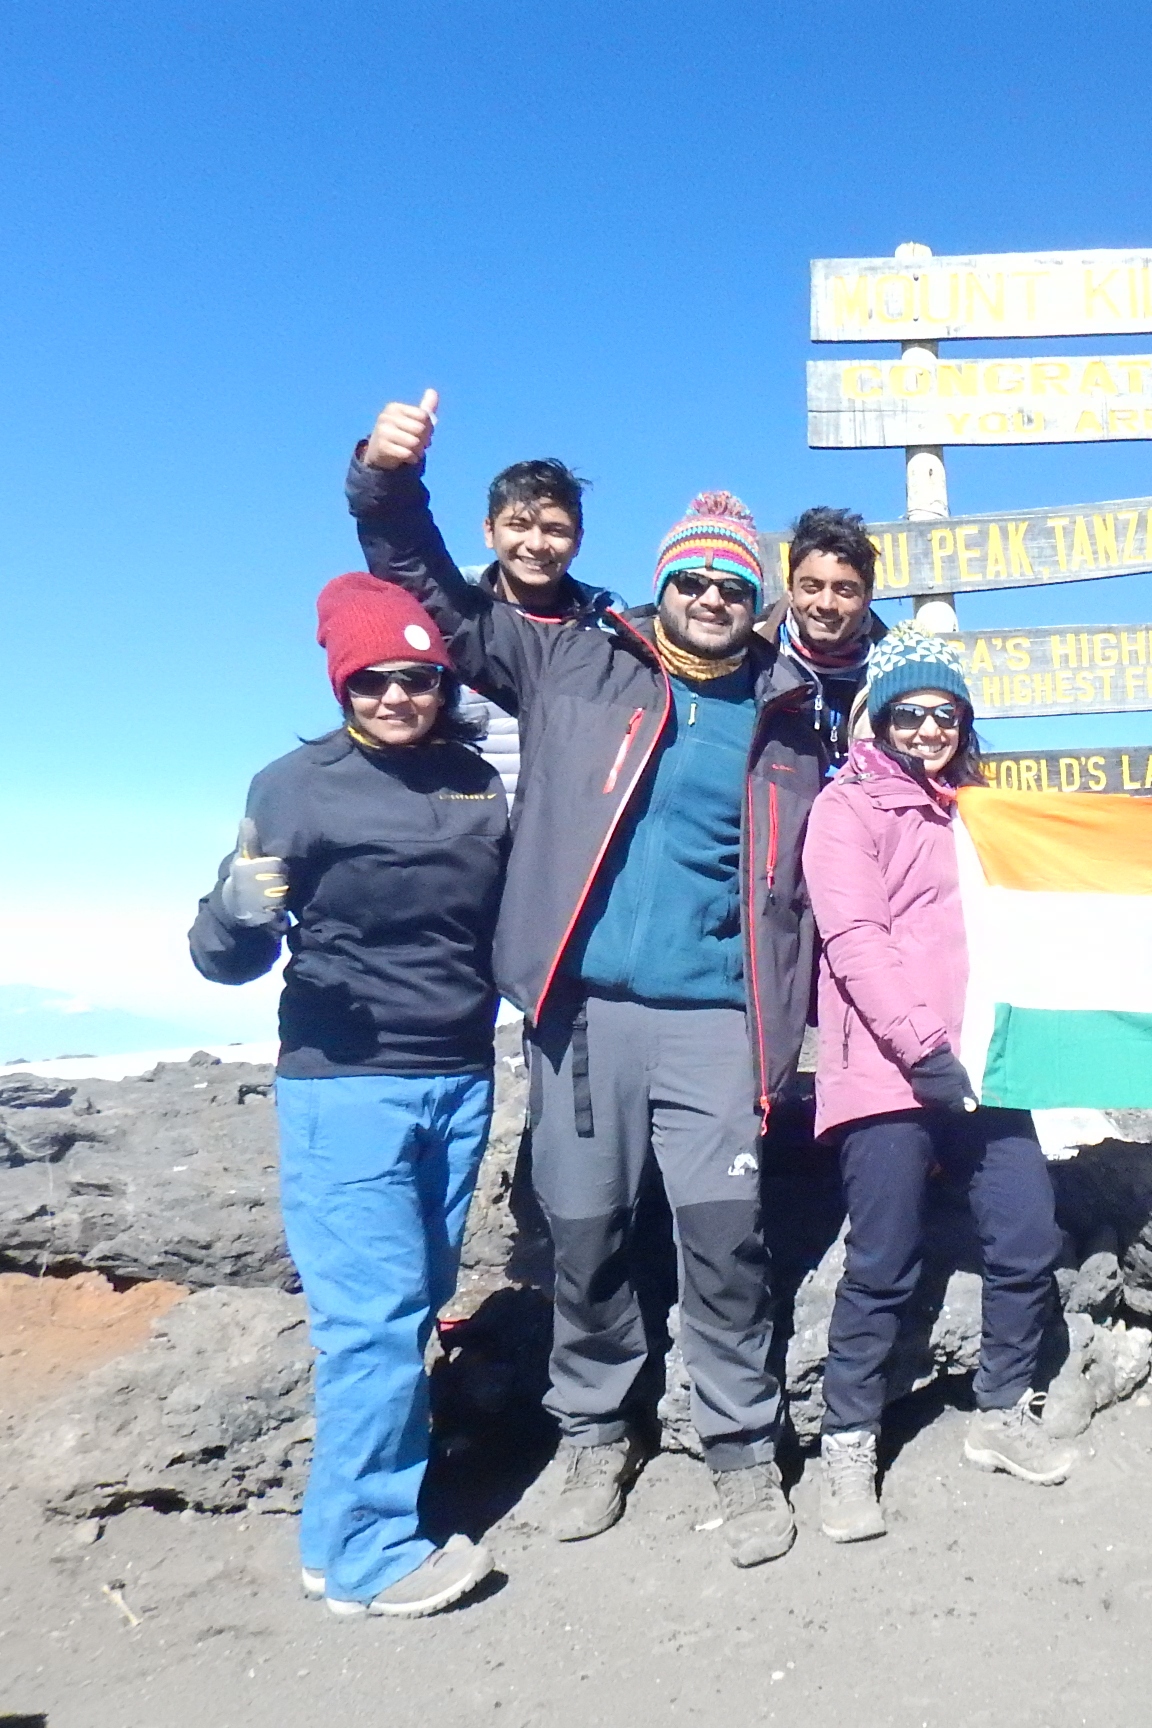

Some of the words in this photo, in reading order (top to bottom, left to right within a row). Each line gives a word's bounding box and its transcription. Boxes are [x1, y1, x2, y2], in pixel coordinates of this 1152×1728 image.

[832, 271, 1050, 327] MOUNT
[945, 410, 1045, 435] YOU
[982, 667, 1116, 707] HIGHEST
